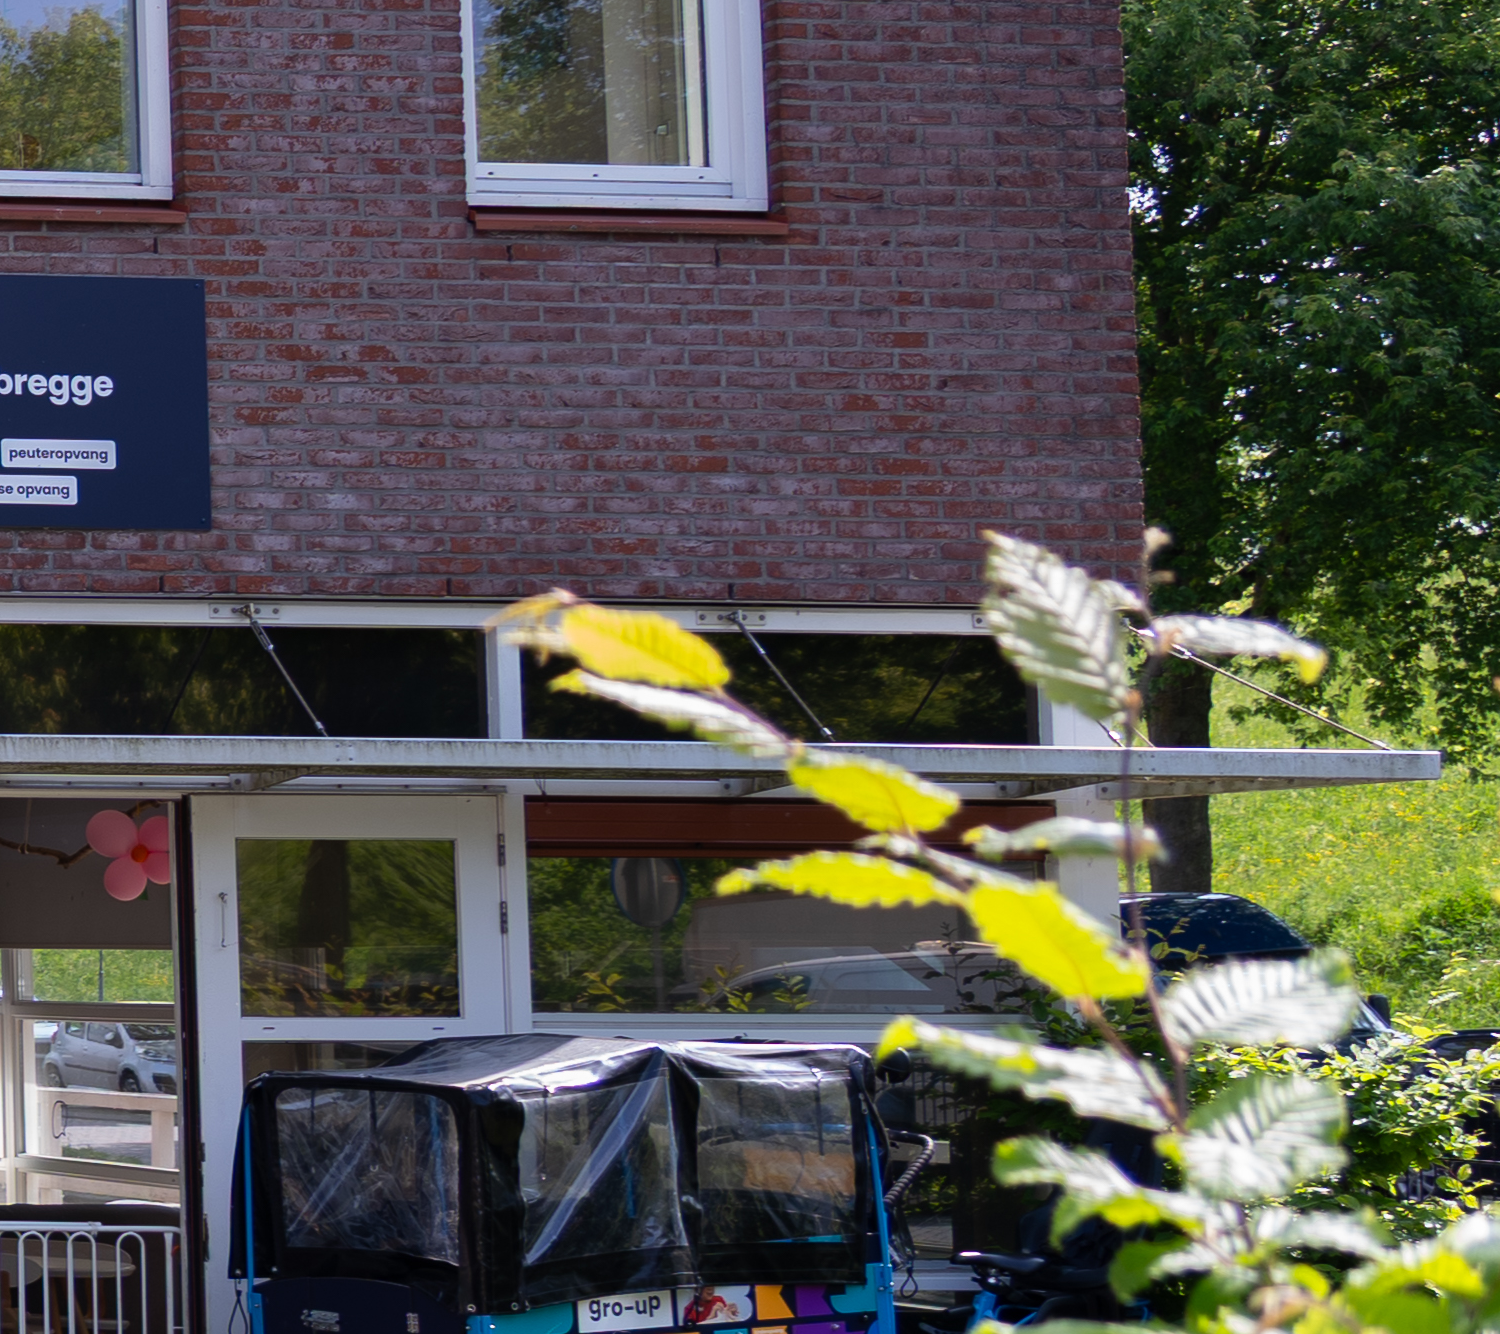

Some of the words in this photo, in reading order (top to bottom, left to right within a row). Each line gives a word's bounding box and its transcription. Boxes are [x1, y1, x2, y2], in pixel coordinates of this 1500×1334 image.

[8, 447, 109, 464] peuteropvang
[16, 484, 70, 500] opvang
[588, 1294, 661, 1322] gro-up
